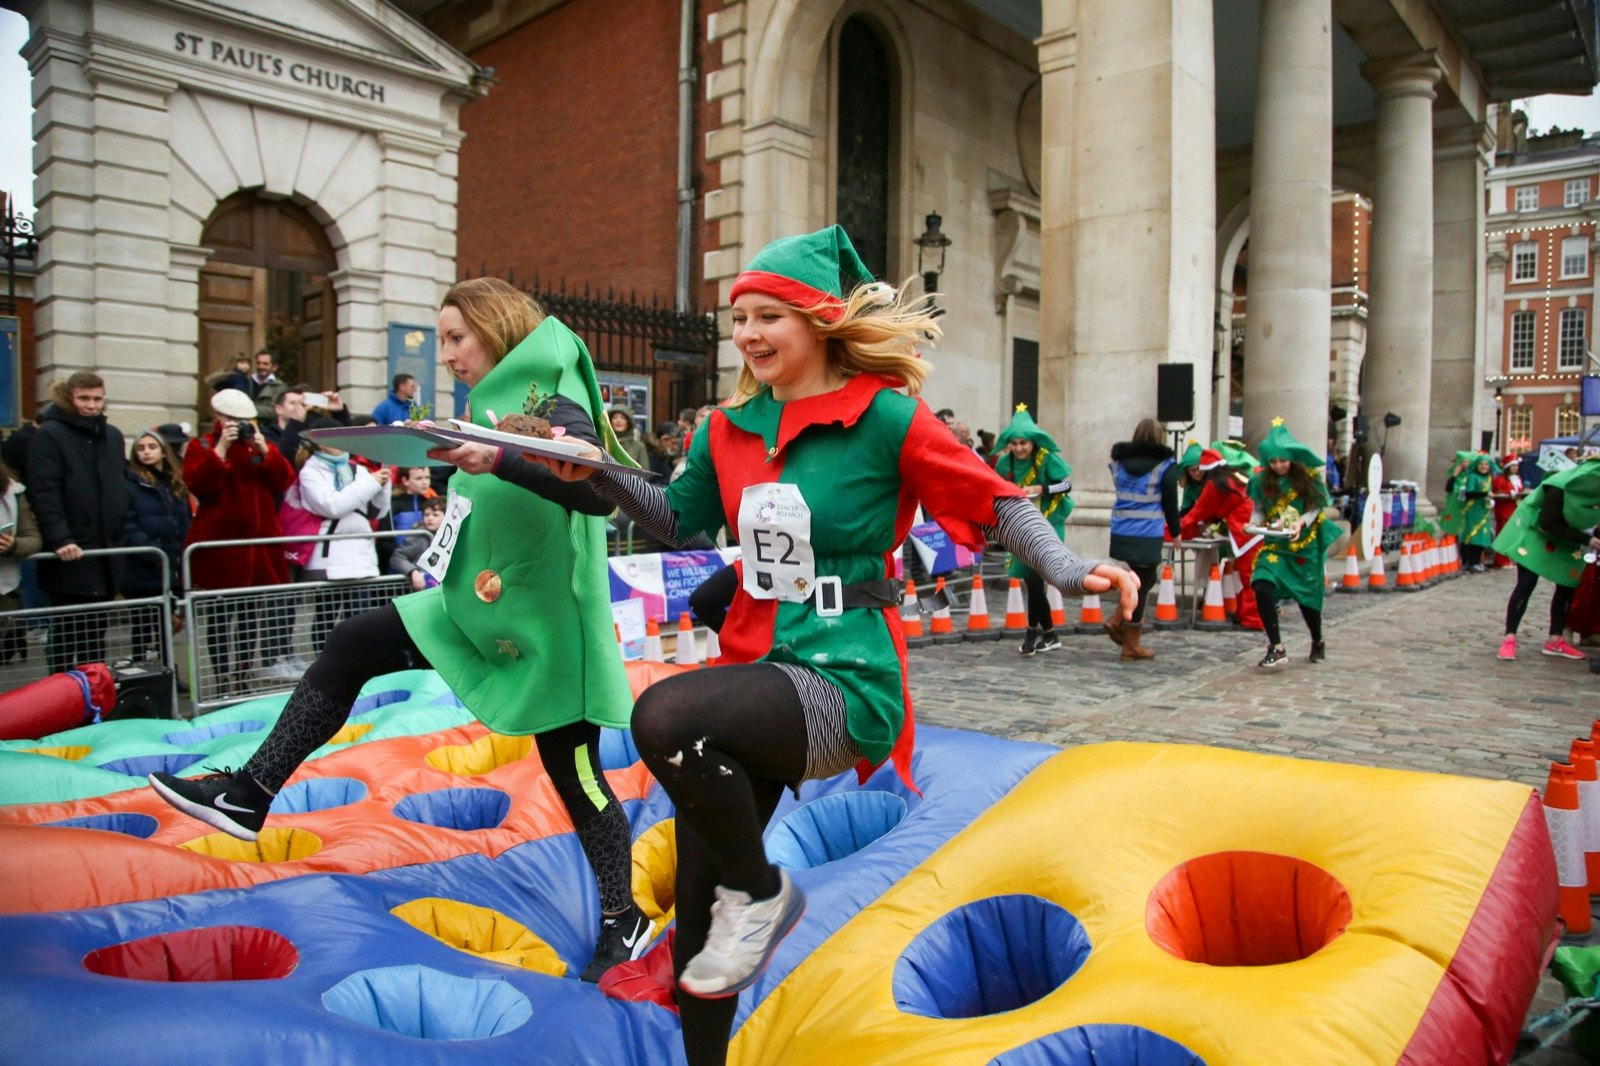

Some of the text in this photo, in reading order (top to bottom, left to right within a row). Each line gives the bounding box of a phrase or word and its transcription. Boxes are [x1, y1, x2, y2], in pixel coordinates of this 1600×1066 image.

[174, 31, 386, 103] ST PAUL'S CHURCH
[753, 528, 801, 566] E2
[666, 568, 681, 579] WE
[667, 579, 682, 589] ON
